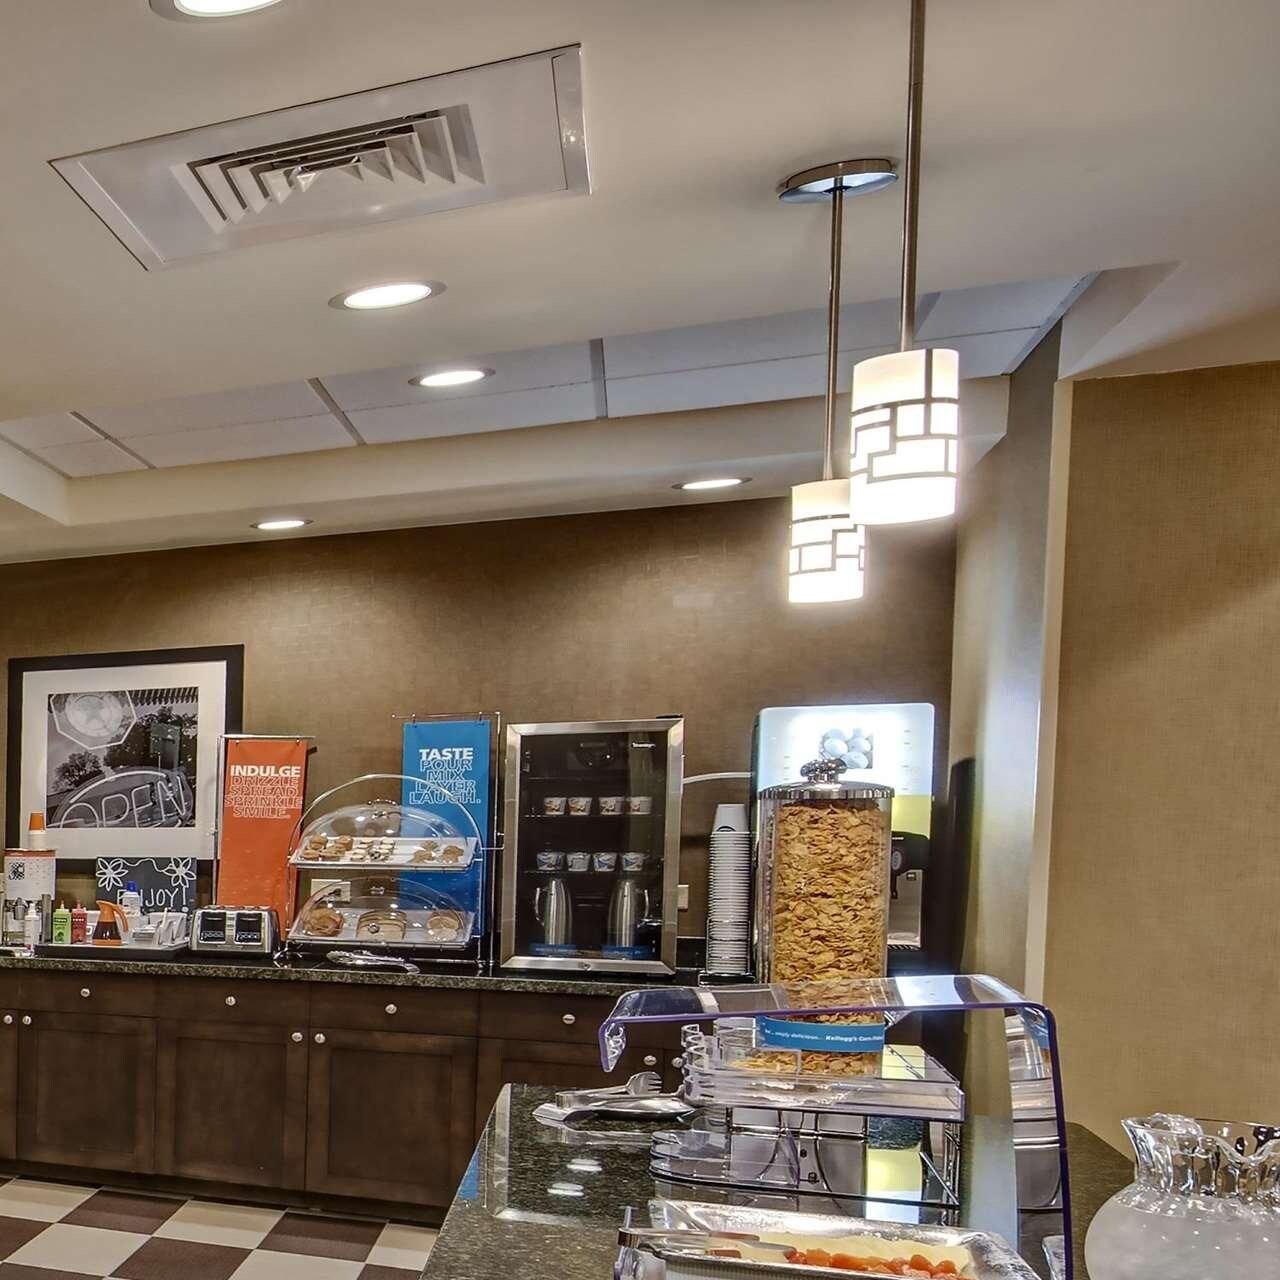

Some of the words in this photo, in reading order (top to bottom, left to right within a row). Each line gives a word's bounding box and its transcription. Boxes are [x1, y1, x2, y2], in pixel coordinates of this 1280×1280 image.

[419, 747, 474, 761] TASTE
[230, 765, 301, 777] INDULGE
[420, 759, 473, 772] POUR
[231, 775, 299, 787] DRIZZLE
[426, 769, 465, 781] MIX
[230, 785, 299, 797] SPREAD
[60, 776, 186, 828] OPEN
[224, 795, 303, 808] SPRINKLE
